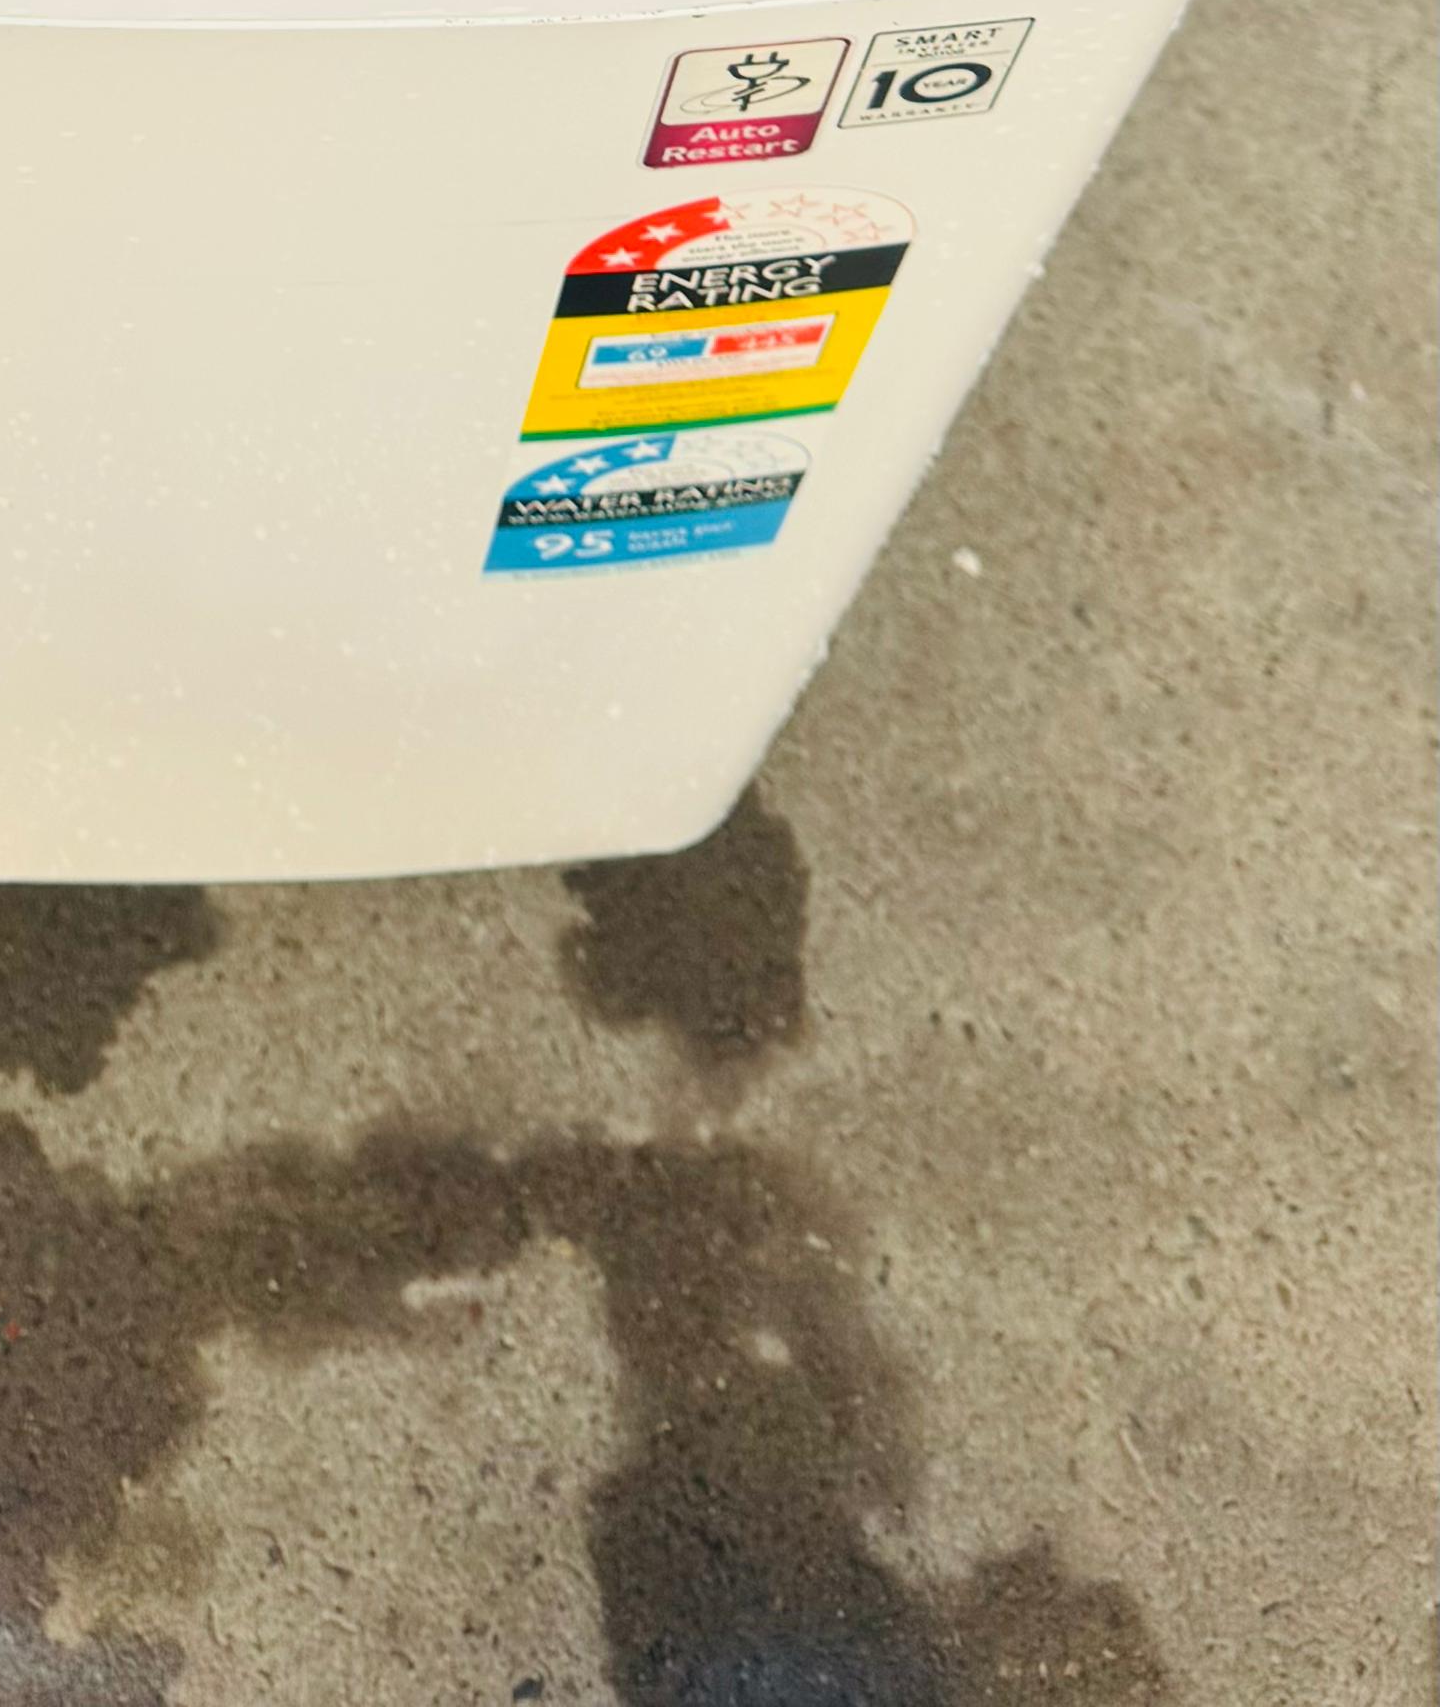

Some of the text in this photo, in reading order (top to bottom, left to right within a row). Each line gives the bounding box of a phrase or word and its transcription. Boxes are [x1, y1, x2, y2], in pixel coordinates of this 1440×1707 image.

[895, 27, 1003, 48] SMART
[867, 62, 993, 110] 10
[922, 78, 968, 89] YEAR
[689, 122, 782, 142] Auto
[661, 138, 800, 163] Restart
[632, 254, 837, 293] ENERGY
[626, 276, 823, 312] RATING
[515, 491, 642, 515] WATER
[533, 528, 615, 561] 95
